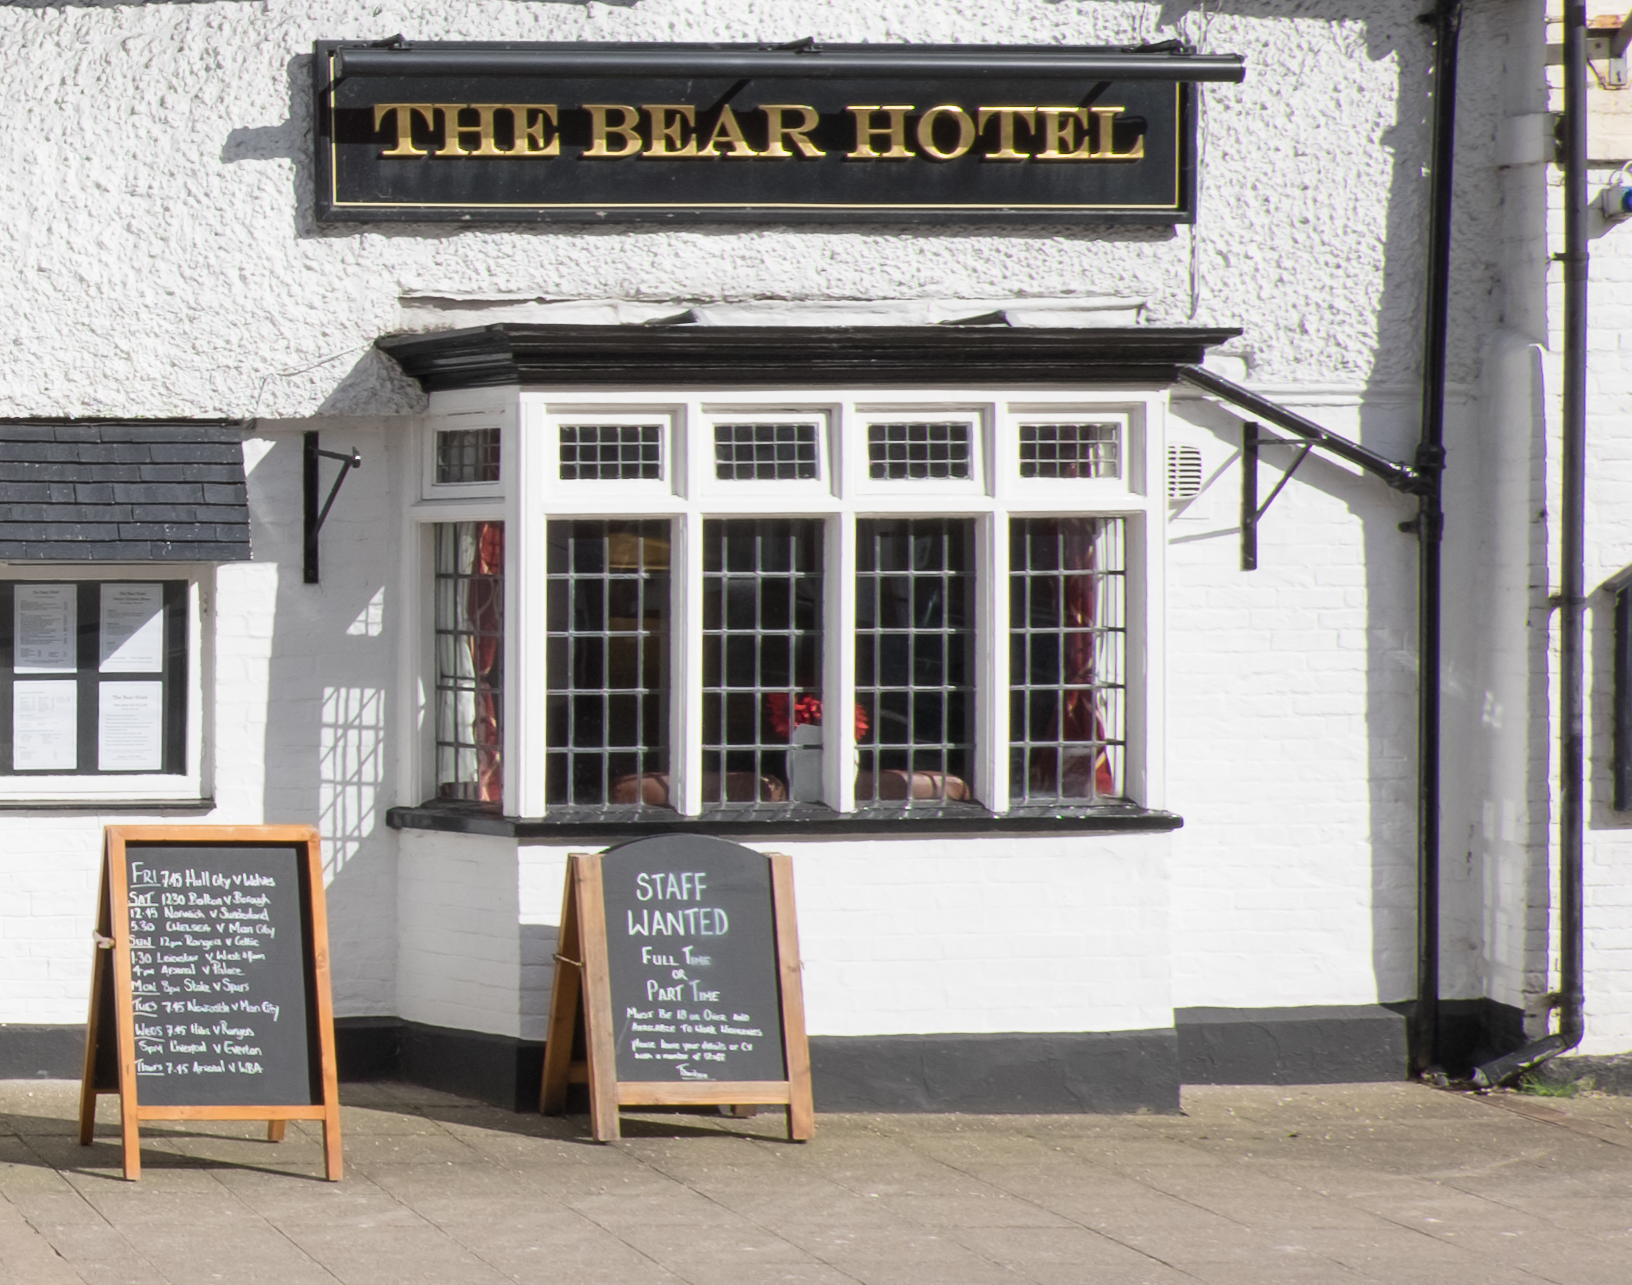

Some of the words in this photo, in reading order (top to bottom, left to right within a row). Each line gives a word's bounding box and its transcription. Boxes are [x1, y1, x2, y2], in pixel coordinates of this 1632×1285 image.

[373, 103, 560, 156] THE
[582, 103, 826, 156] BEAR
[846, 105, 1144, 160] HOTEL
[636, 872, 707, 901] STAFF
[627, 908, 729, 936] WANTED
[671, 969, 689, 980] OR
[676, 1009, 687, 1020] 18
